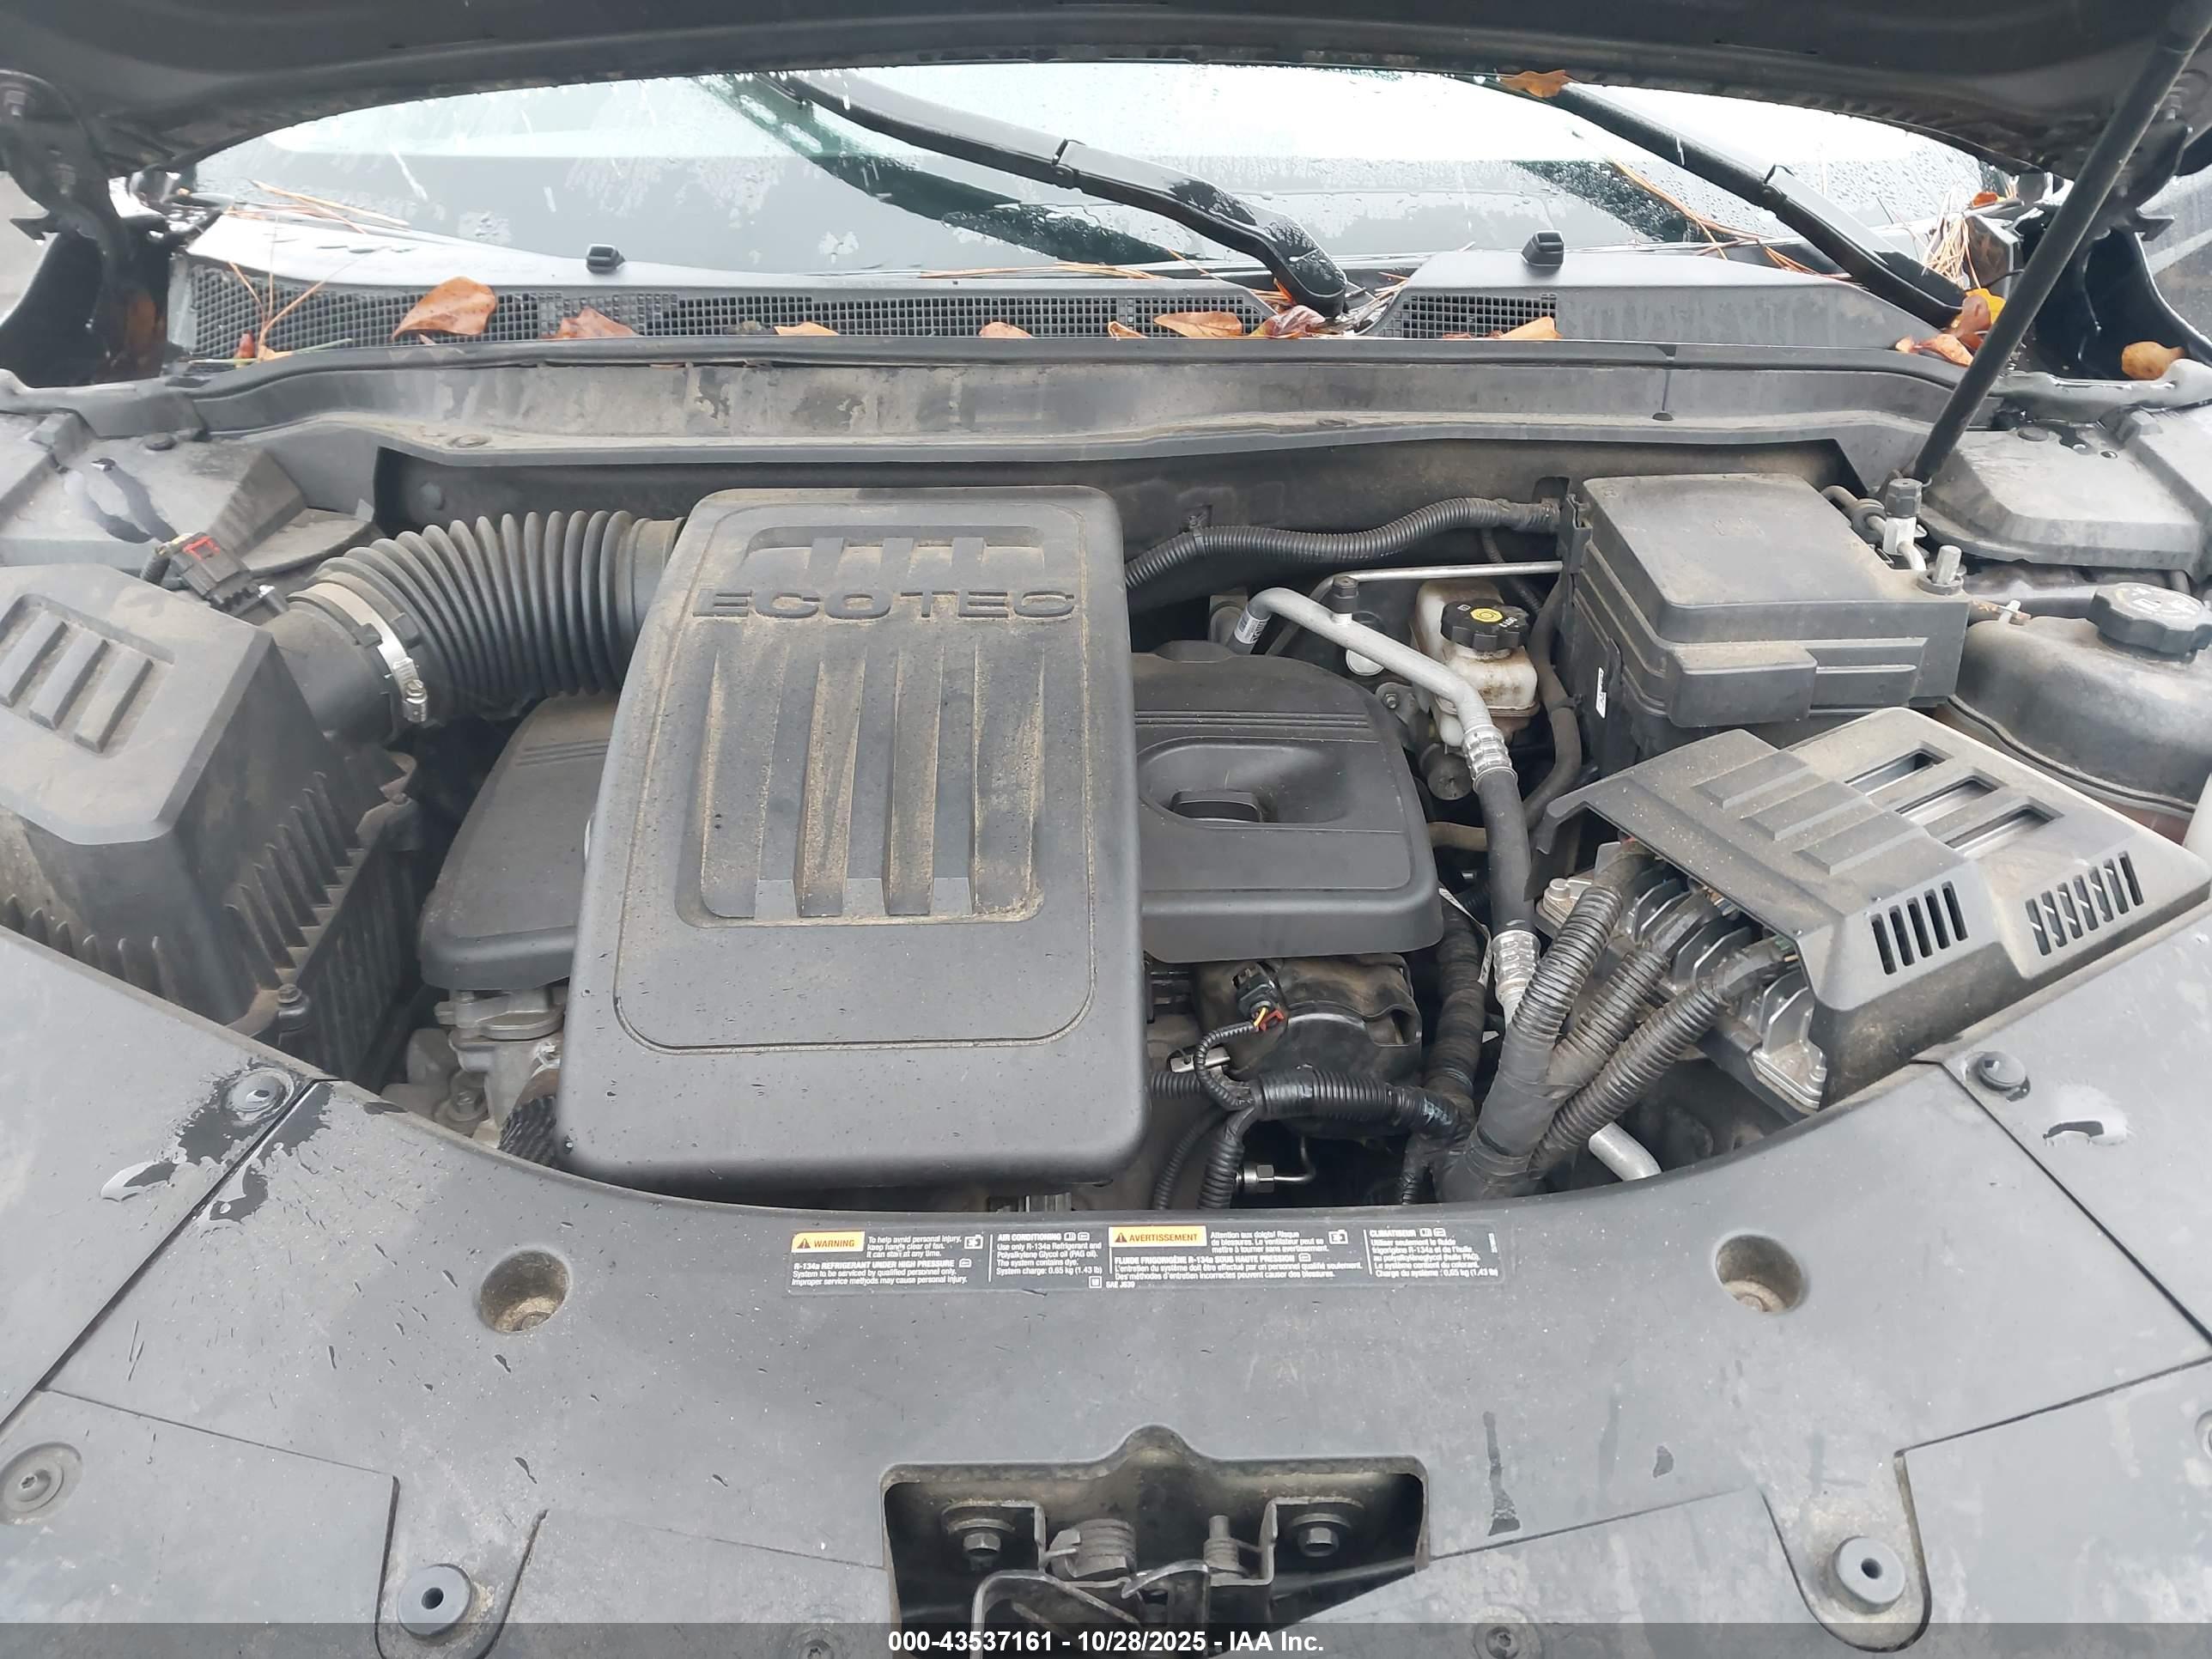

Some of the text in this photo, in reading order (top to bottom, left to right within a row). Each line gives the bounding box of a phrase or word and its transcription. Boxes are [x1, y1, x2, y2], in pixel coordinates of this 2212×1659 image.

[693, 588, 1074, 619] ECOTEC
[1129, 1233, 1197, 1242] AVERTISSEMENT
[1277, 1231, 1299, 1239] Risque
[877, 1236, 891, 1244] help
[912, 1236, 940, 1244] personal
[1012, 1243, 1024, 1251] only
[1052, 1242, 1089, 1250] Refrigerant
[997, 1251, 1037, 1260] Polyalkylene
[1069, 1250, 1085, 1259] (PAG
[1140, 1255, 1187, 1264] FRIGORIGÈNE
[1011, 1260, 1035, 1268] system
[1302, 1262, 1325, 1271] qualifié
[996, 1267, 1021, 1276] System
[1023, 1267, 1047, 1276] charge:
[1065, 1267, 1073, 1275] kg
[1075, 1267, 1092, 1275] (1.43
[849, 1277, 878, 1285] methods
[917, 1276, 945, 1285] personal
